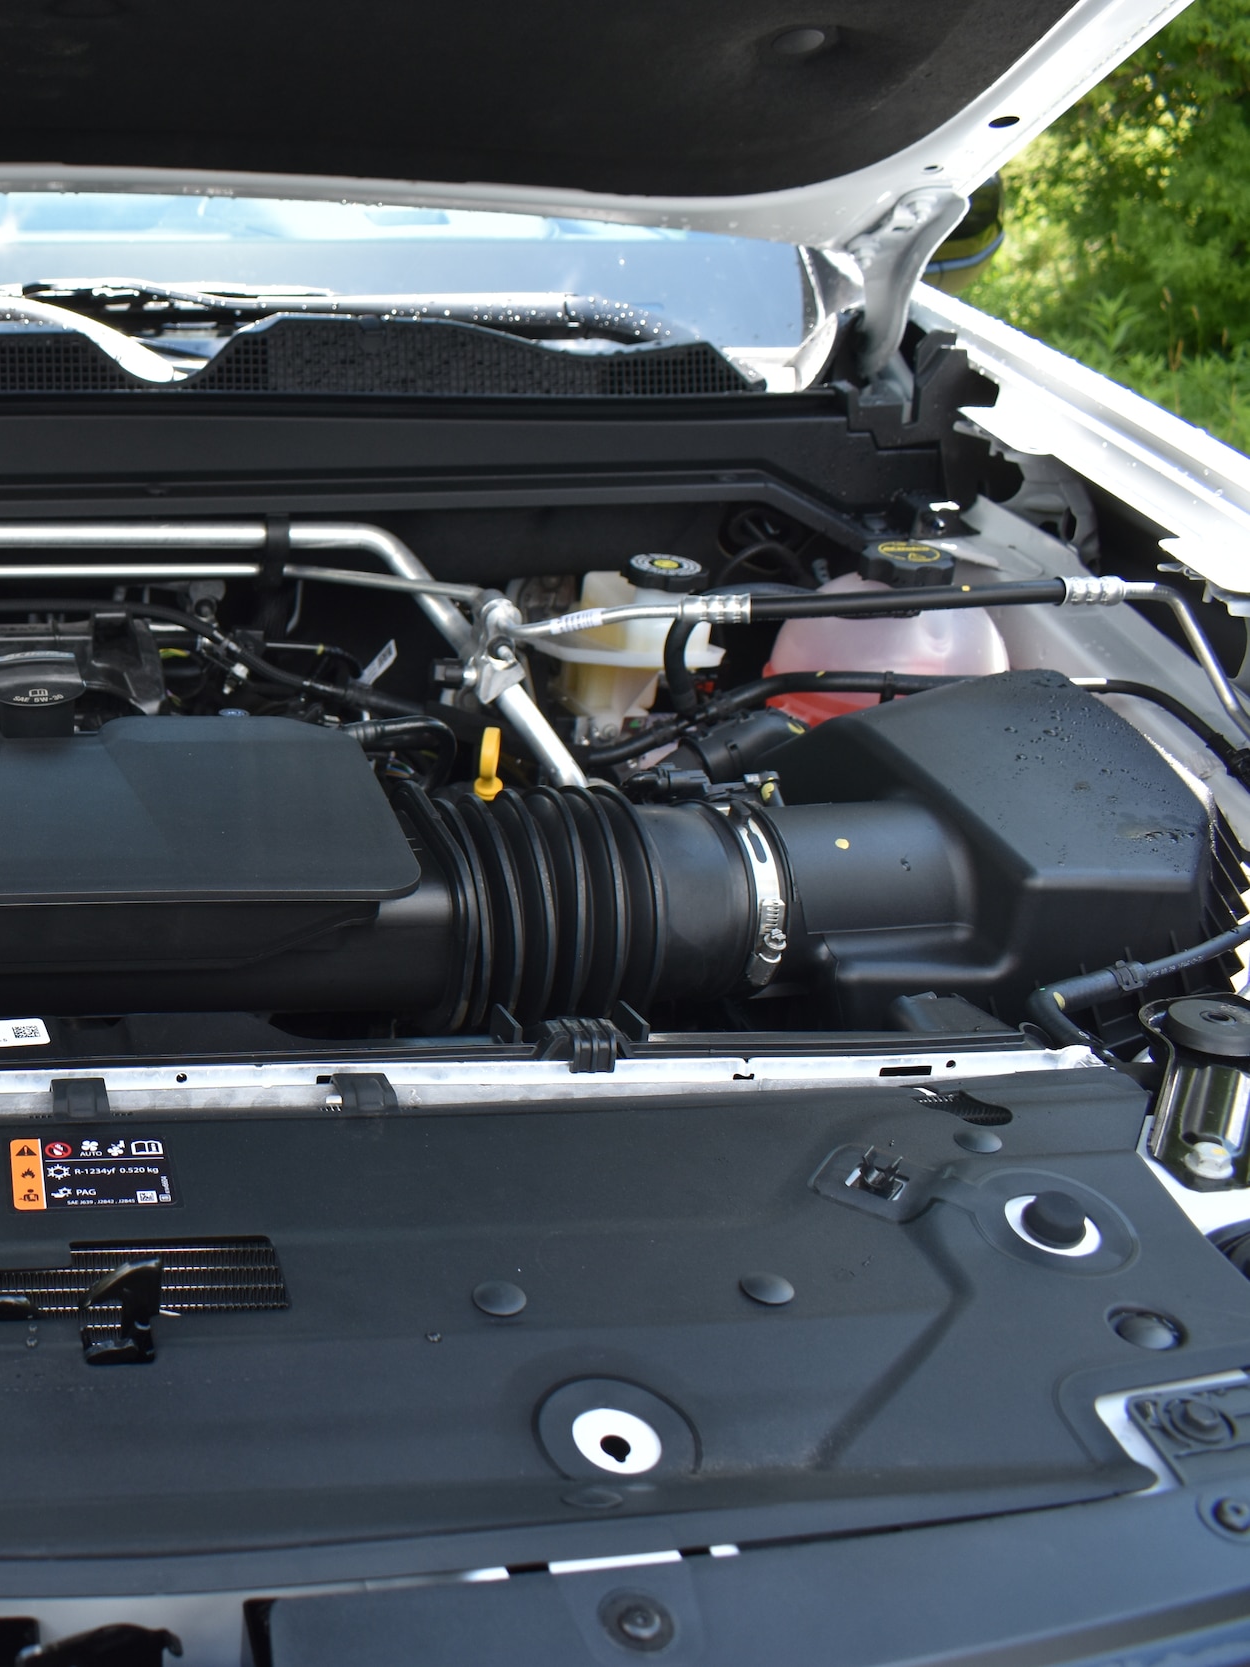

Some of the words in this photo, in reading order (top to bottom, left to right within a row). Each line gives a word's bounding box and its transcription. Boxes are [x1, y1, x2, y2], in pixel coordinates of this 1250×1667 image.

[13, 695, 30, 703] SAE
[34, 694, 64, 703] 5W-30
[74, 1167, 116, 1175] R-1234yf
[147, 1166, 159, 1174] kg
